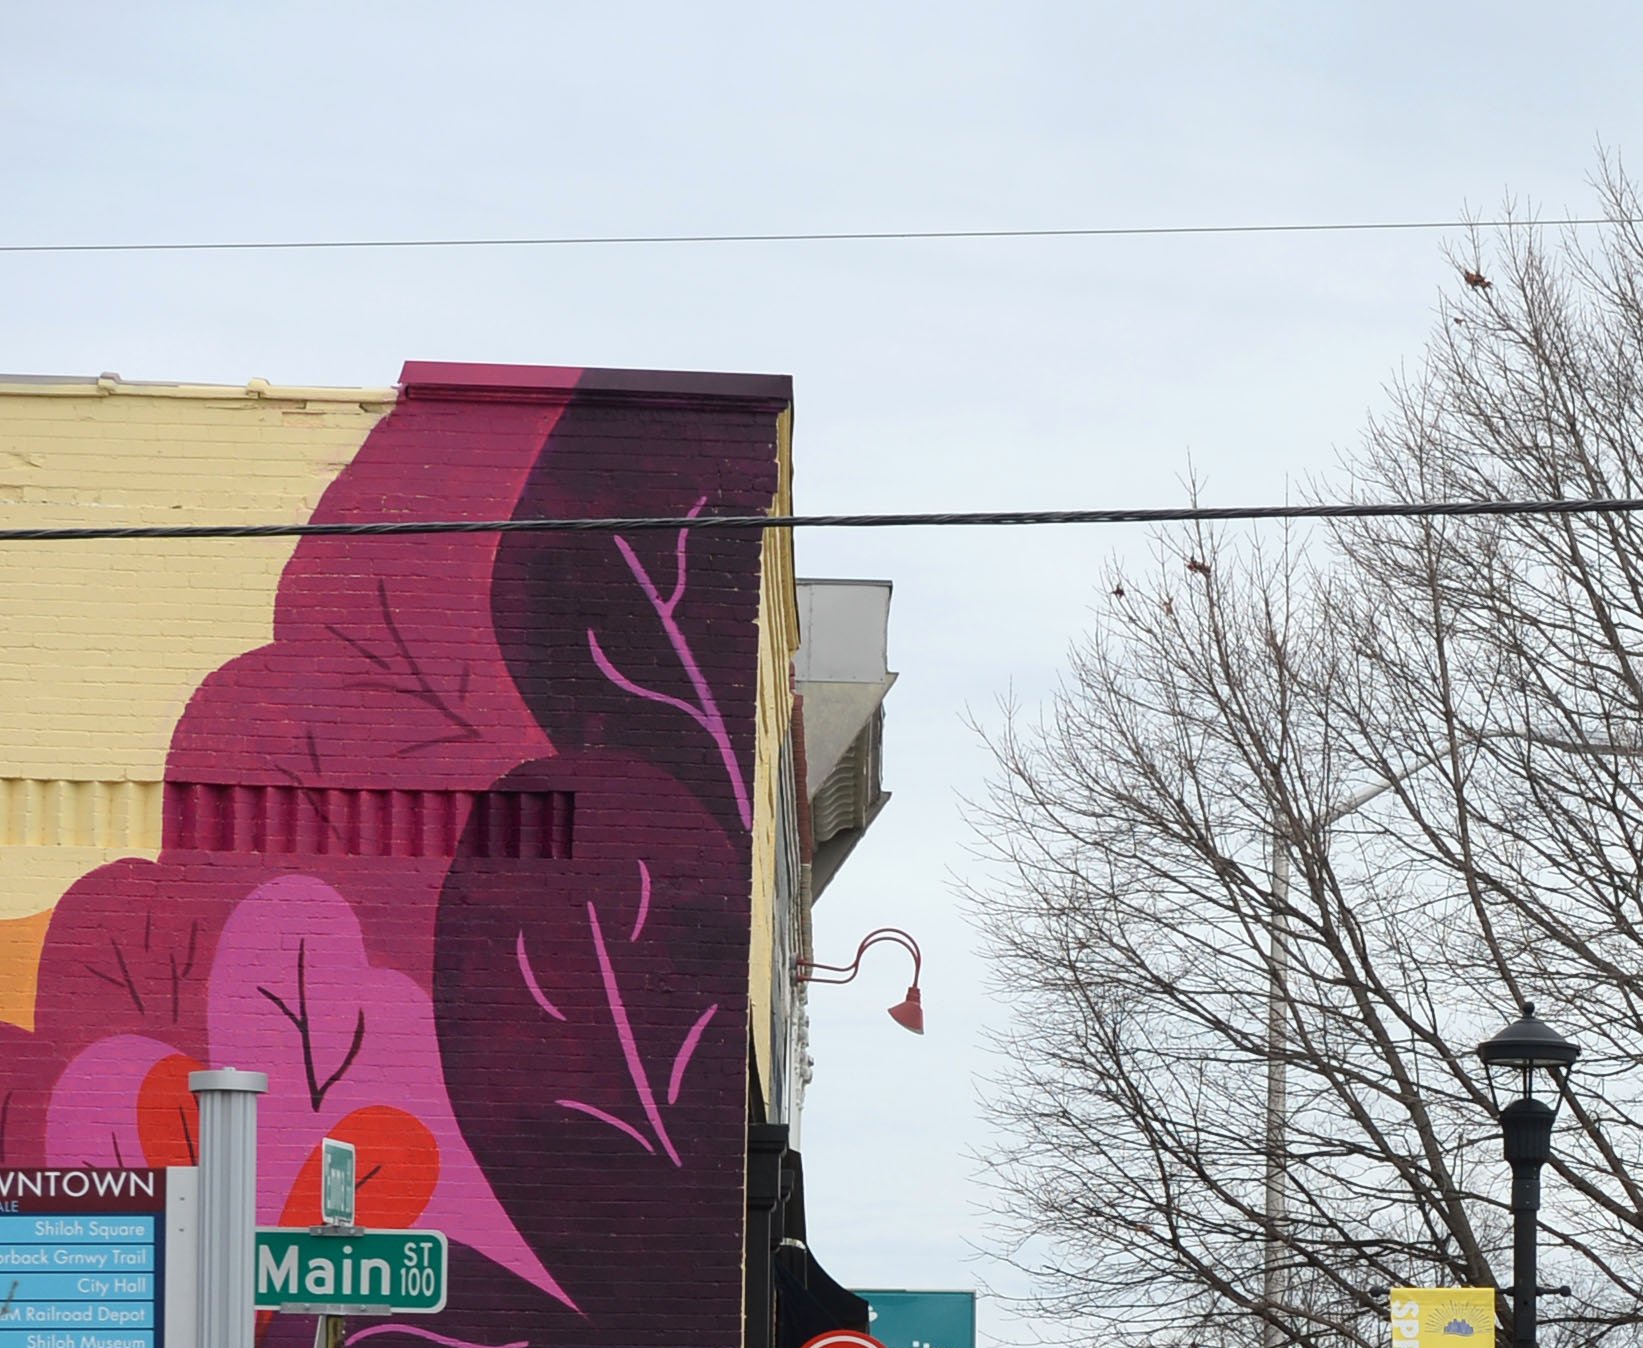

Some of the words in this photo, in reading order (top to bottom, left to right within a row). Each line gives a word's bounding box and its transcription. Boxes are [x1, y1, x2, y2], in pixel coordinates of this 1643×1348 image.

[34, 1221, 84, 1236] Shiloh
[88, 1221, 145, 1240] Square
[54, 1250, 108, 1268] Grnwy
[112, 1250, 147, 1265] Trail
[258, 1245, 391, 1296] Main
[403, 1242, 433, 1267] ST
[77, 1277, 109, 1297] City
[114, 1278, 147, 1293] Hall
[400, 1267, 435, 1297] 100
[26, 1306, 93, 1321] Railroad
[98, 1306, 145, 1325] Depot
